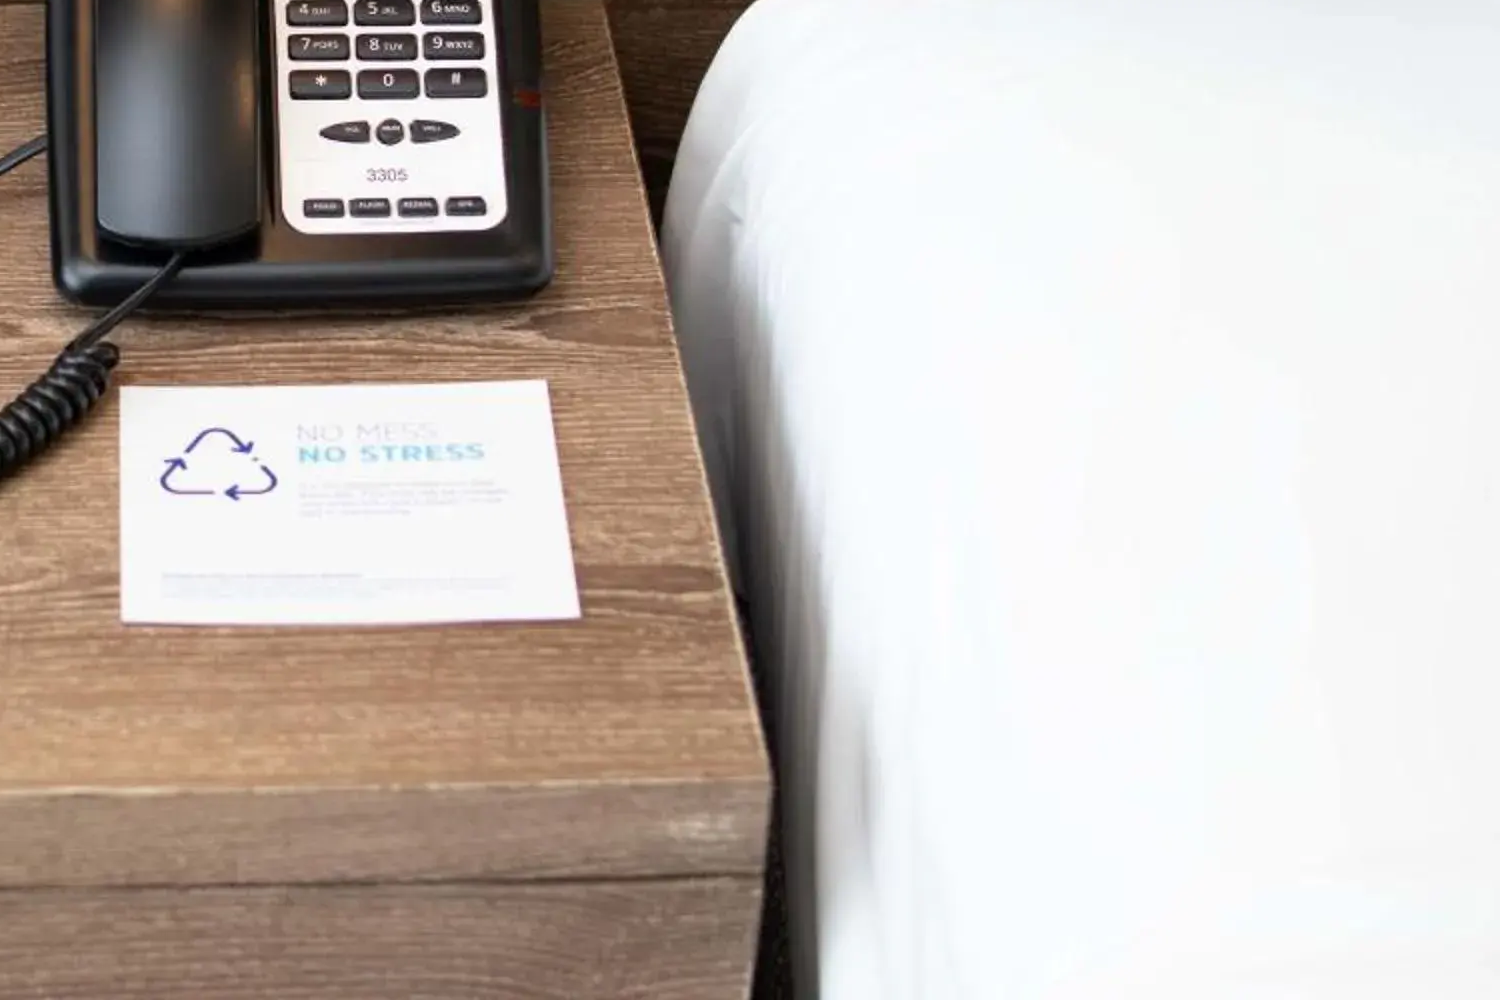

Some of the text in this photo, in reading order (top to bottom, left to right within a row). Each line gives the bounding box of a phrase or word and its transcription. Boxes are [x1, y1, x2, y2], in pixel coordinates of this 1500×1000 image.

[299, 4, 309, 15] 4
[368, 2, 378, 15] 5
[431, 1, 442, 13] 6
[301, 37, 311, 49] 7
[369, 38, 380, 50] 8
[432, 36, 443, 49] 9
[383, 73, 395, 86] 0
[366, 168, 408, 182] 3305
[296, 423, 439, 441] NO MESS
[298, 443, 486, 463] NO STRESS
